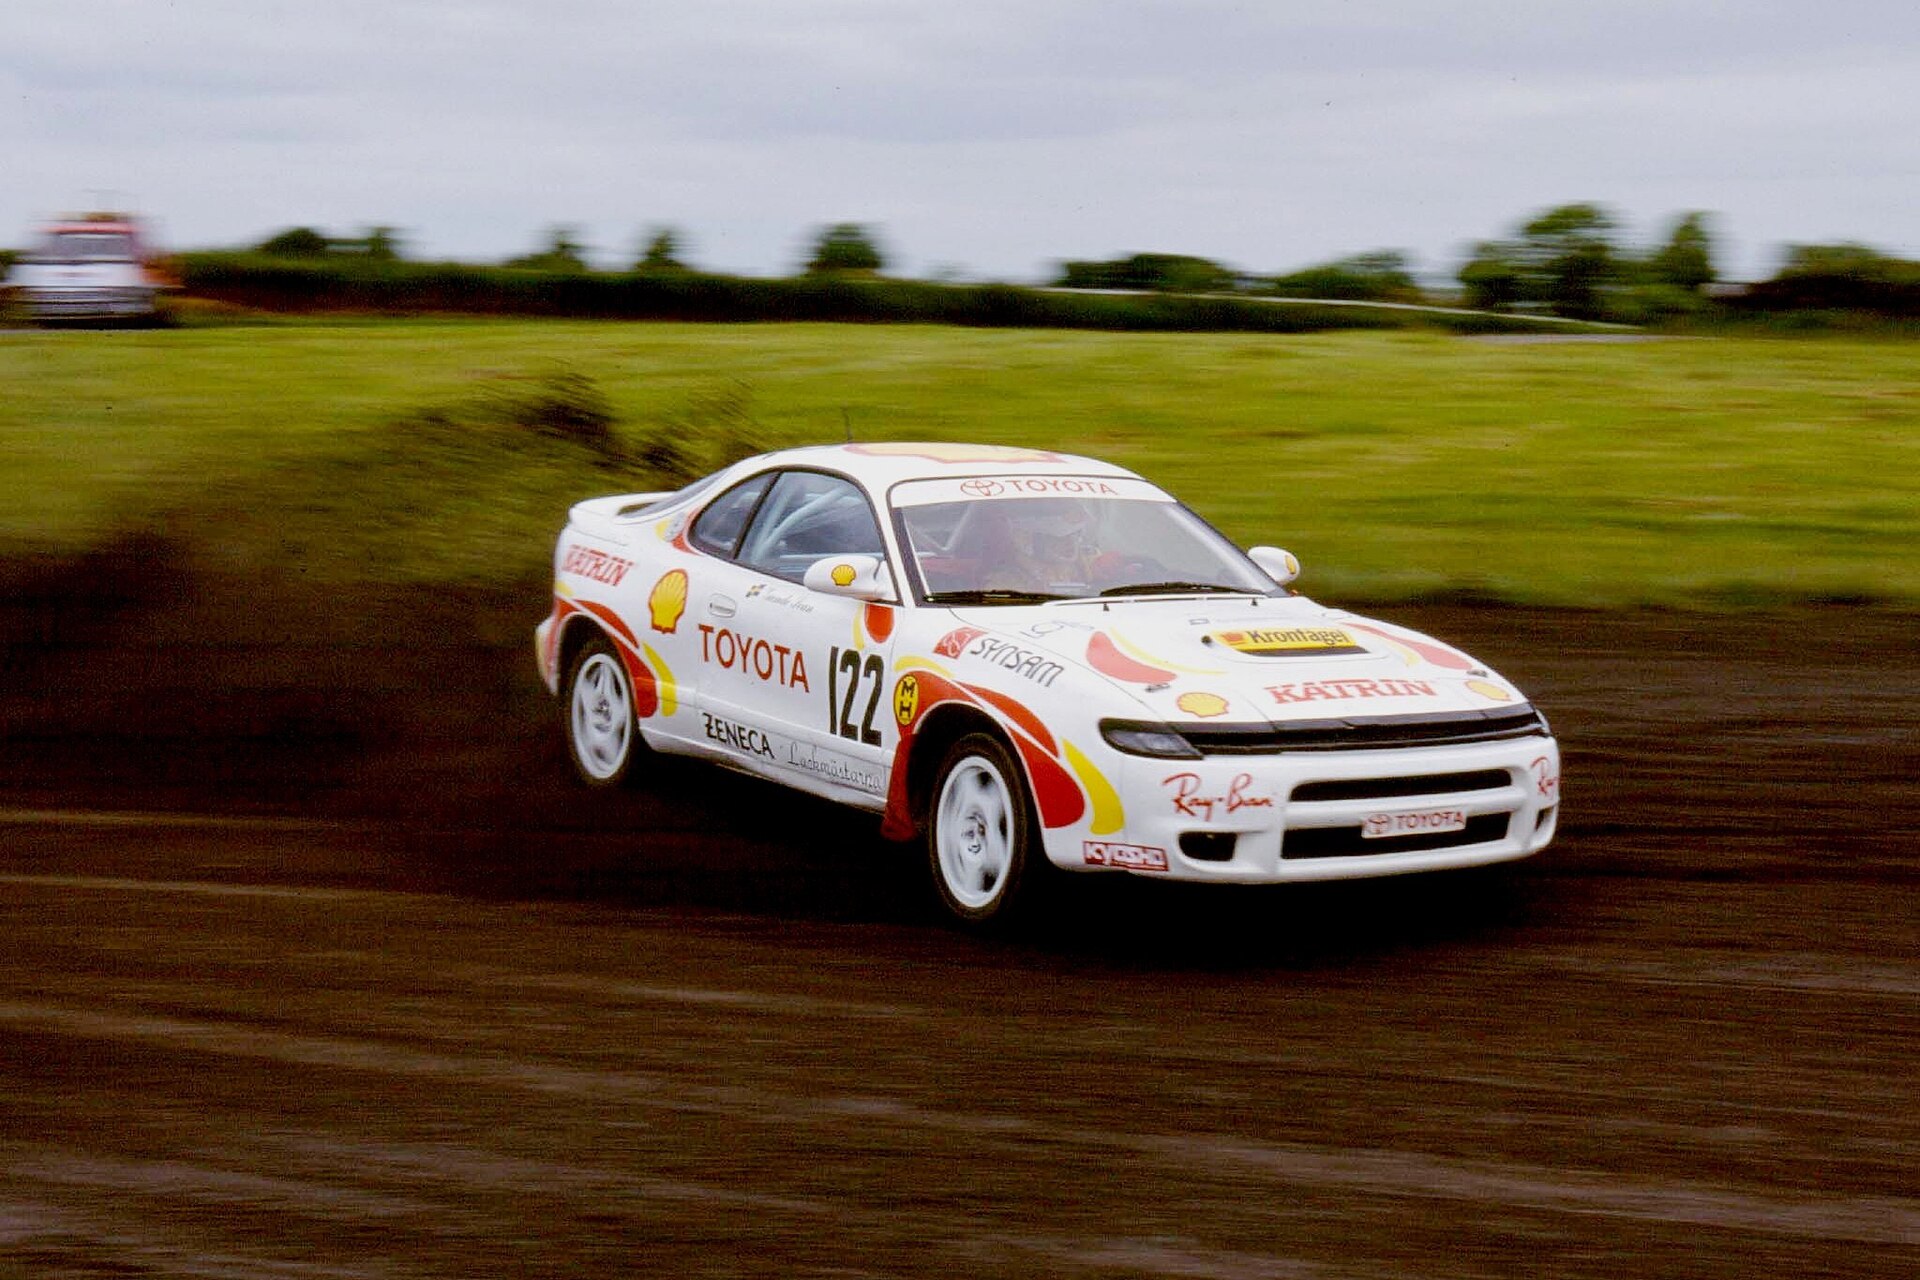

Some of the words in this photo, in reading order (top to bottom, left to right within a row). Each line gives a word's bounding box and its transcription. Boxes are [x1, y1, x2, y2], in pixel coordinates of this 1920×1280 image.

[1005, 480, 1118, 495] TOYOTA
[698, 623, 810, 693] TOYOTA
[970, 637, 1064, 687] SYNSAM
[828, 645, 885, 748] 122
[1264, 678, 1437, 704] KATRIN
[702, 712, 775, 760] ZENECA
[1162, 772, 1273, 822] Ray-Ban
[1395, 811, 1464, 829] TOYOTA
